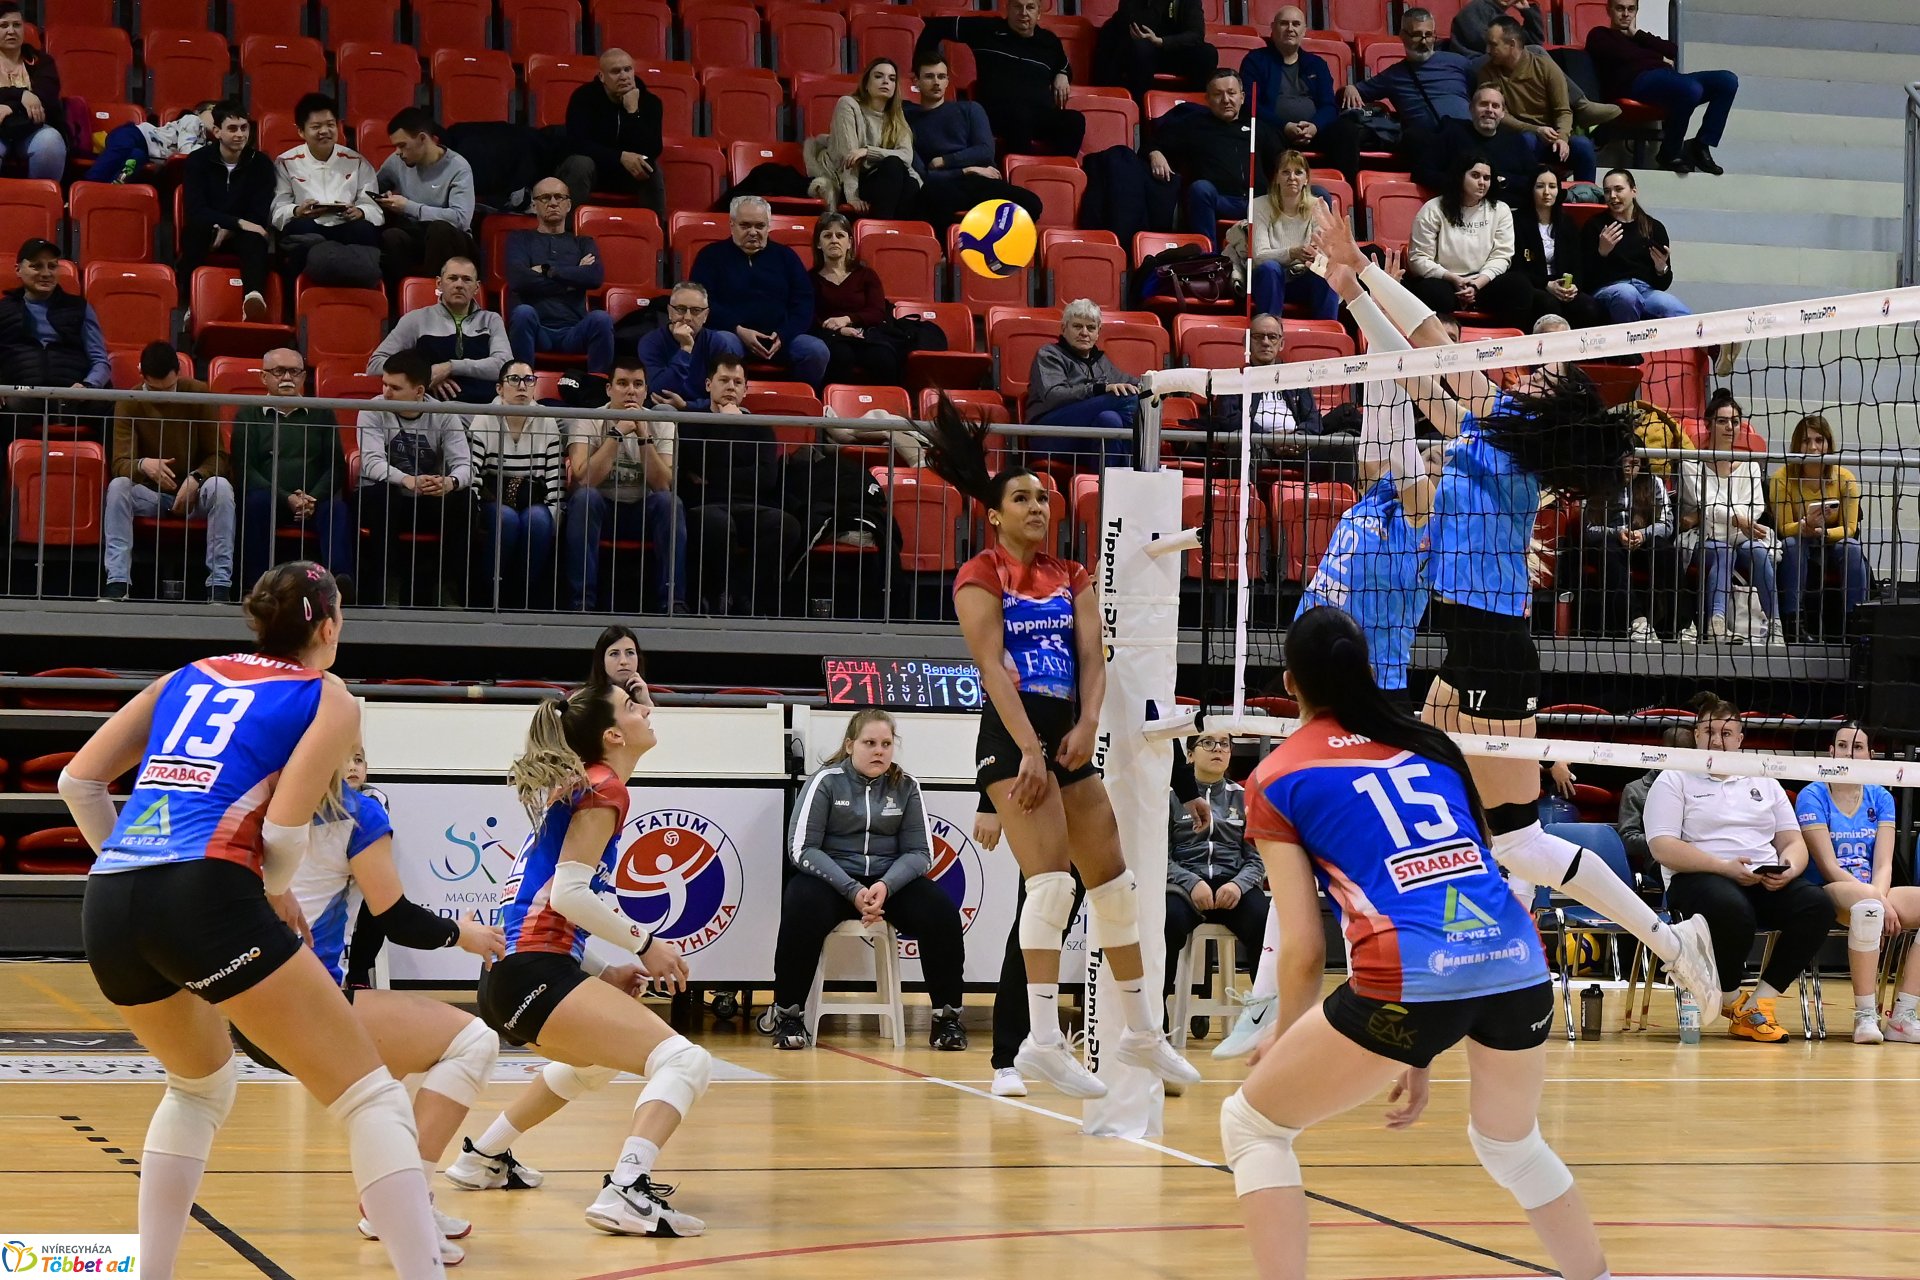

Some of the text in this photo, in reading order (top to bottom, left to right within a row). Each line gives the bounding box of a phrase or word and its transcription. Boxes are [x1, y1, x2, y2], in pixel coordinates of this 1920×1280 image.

[1800, 306, 1837, 324] TippmixPRO
[1626, 328, 1658, 344] TippmixPRO
[827, 661, 877, 673] FATUM
[922, 663, 980, 676] Benedek
[831, 673, 874, 704] 21
[886, 684, 924, 693] 2 S 2
[903, 693, 911, 702] V
[934, 676, 977, 706] 19
[1467, 690, 1487, 711] 17
[161, 684, 255, 758] 13
[143, 765, 211, 784] STRABAG
[1352, 763, 1459, 850] 15
[635, 812, 709, 836] FATUM
[1394, 850, 1479, 880] STRABAG
[445, 892, 498, 903] MAGYAR
[1446, 930, 1485, 943] KE-VIZ
[1487, 927, 1502, 937] 21
[185, 946, 261, 990] TippmixPRO
[504, 983, 547, 1031] TippmixPRO
[1087, 948, 1104, 1074] TippmixPR
